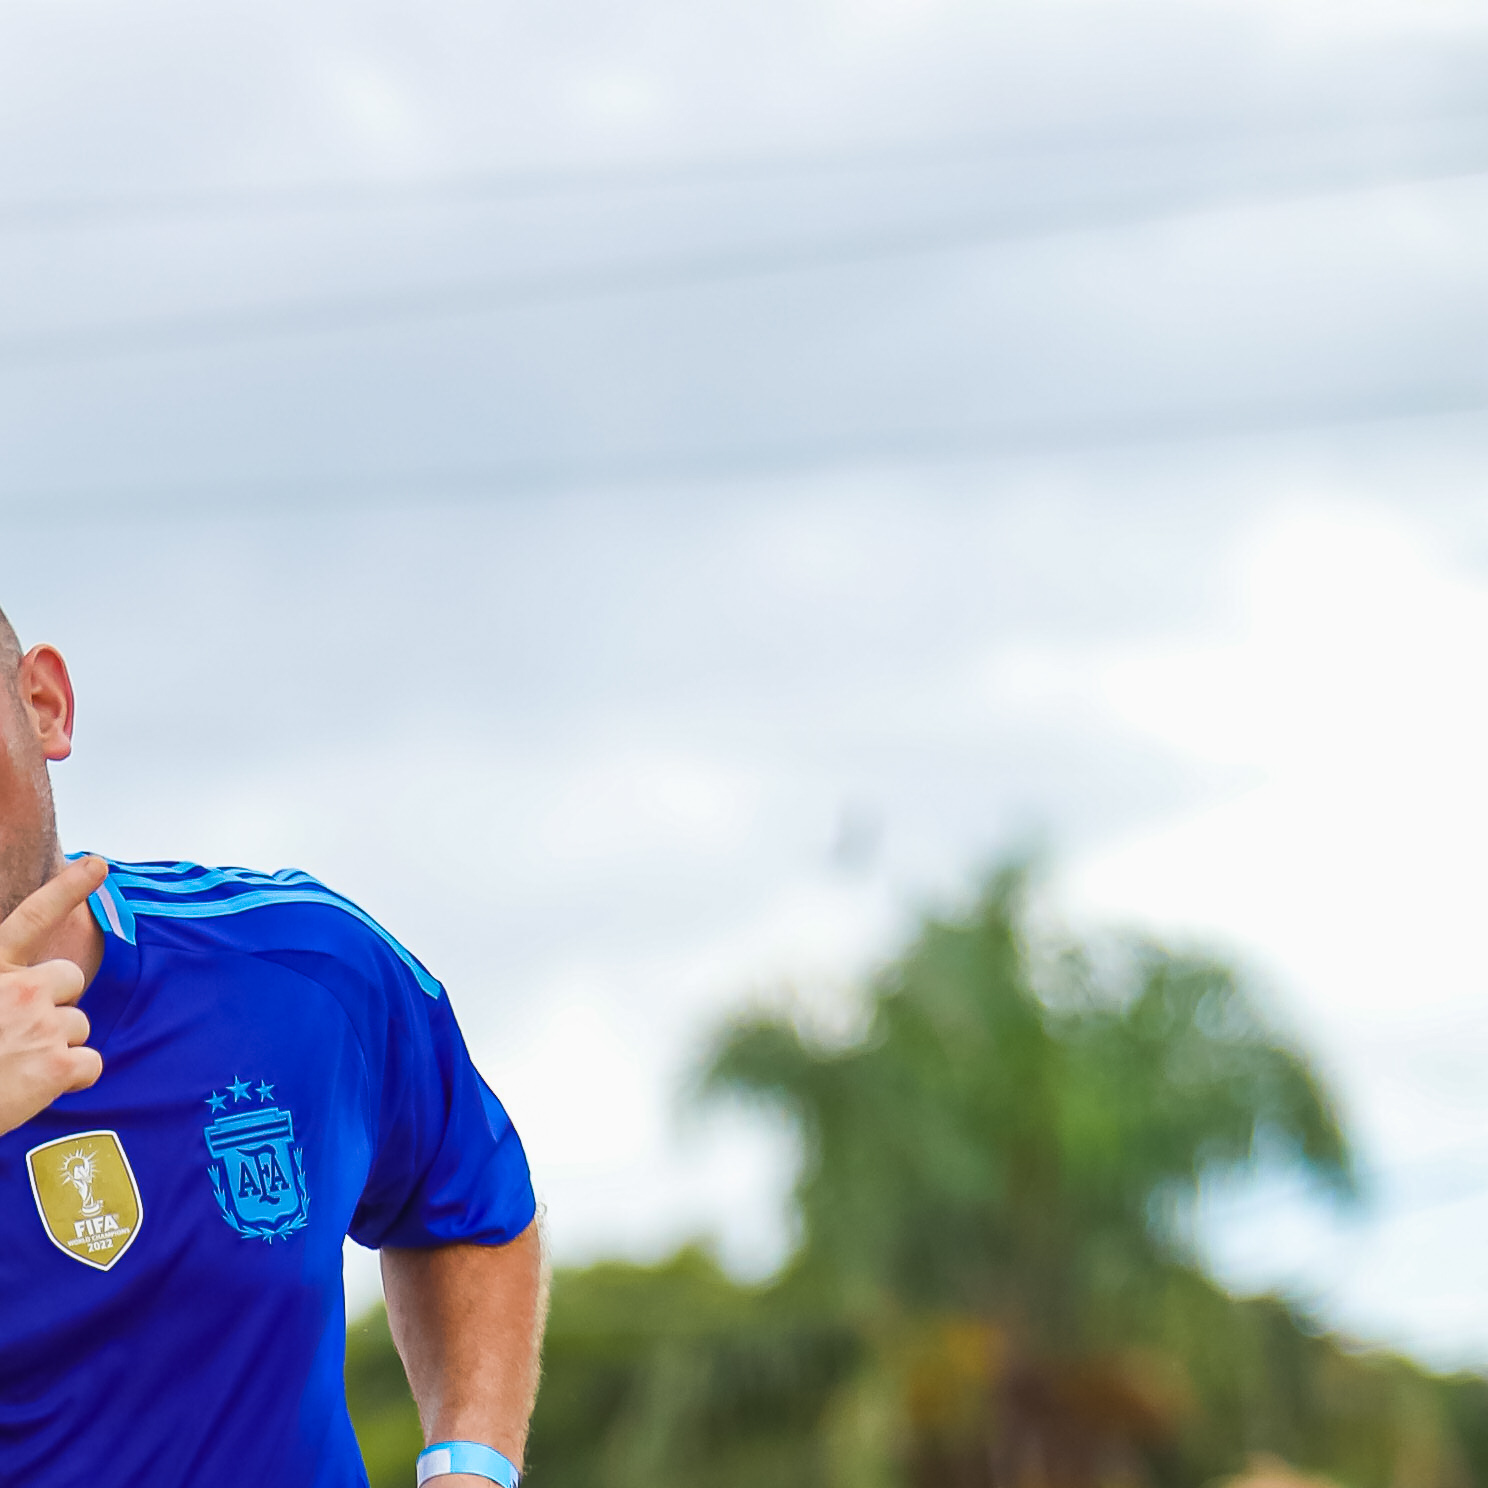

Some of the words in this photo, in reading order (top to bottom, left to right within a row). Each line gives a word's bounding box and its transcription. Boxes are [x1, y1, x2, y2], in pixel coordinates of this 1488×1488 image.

[236, 1144, 290, 1205] AFA
[74, 1214, 119, 1238] FIFA
[88, 1238, 113, 1253] 2022
